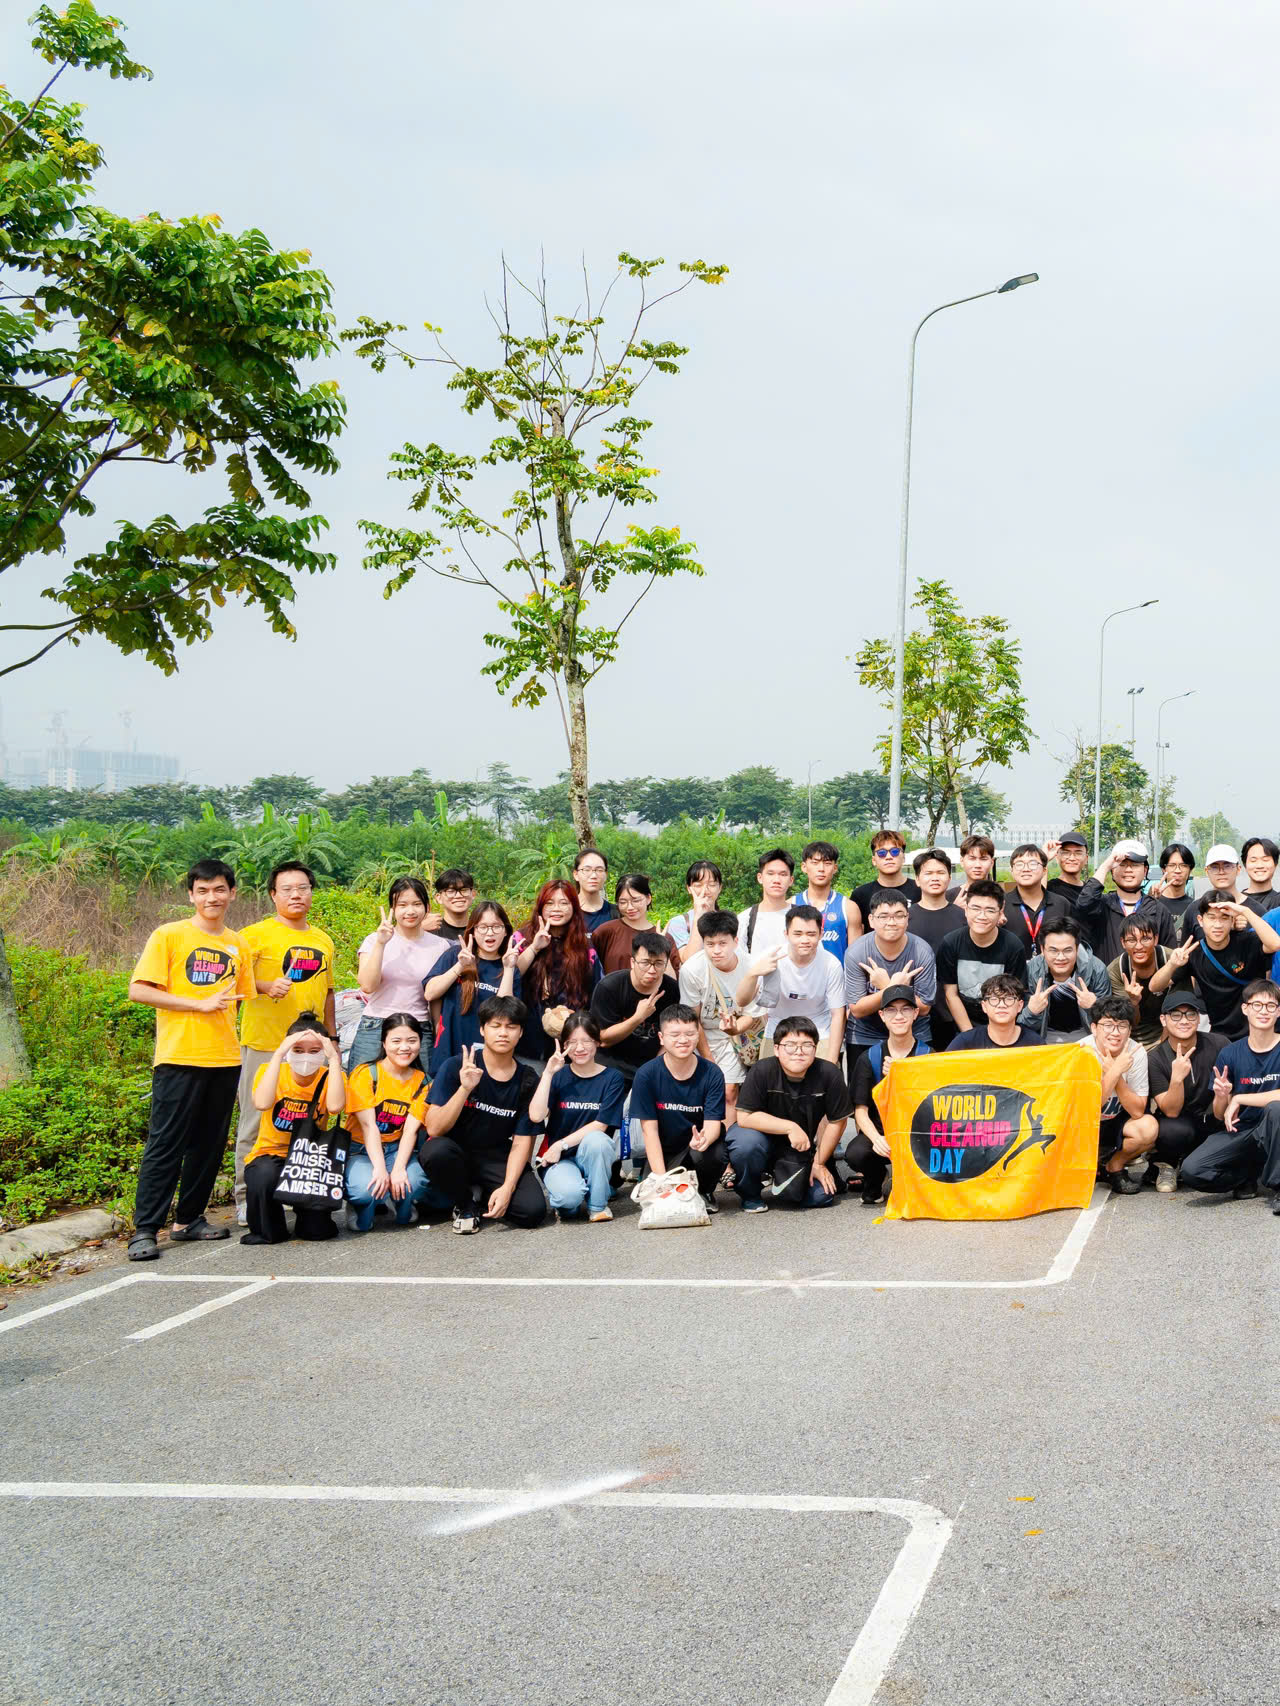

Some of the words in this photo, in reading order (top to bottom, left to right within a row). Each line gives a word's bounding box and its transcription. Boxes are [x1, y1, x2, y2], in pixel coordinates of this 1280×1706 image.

[193, 960, 225, 974] CLEANUP
[192, 971, 208, 983] DAY
[383, 1101, 407, 1116] WORLD
[932, 1094, 997, 1120] WORLD
[274, 1118, 291, 1129] DAY
[930, 1121, 1011, 1147] CLEANUP
[293, 1138, 328, 1155] ONCE
[288, 1151, 332, 1171] AMSER
[929, 1148, 965, 1174] DAY
[280, 1164, 344, 1187] FOREVER
